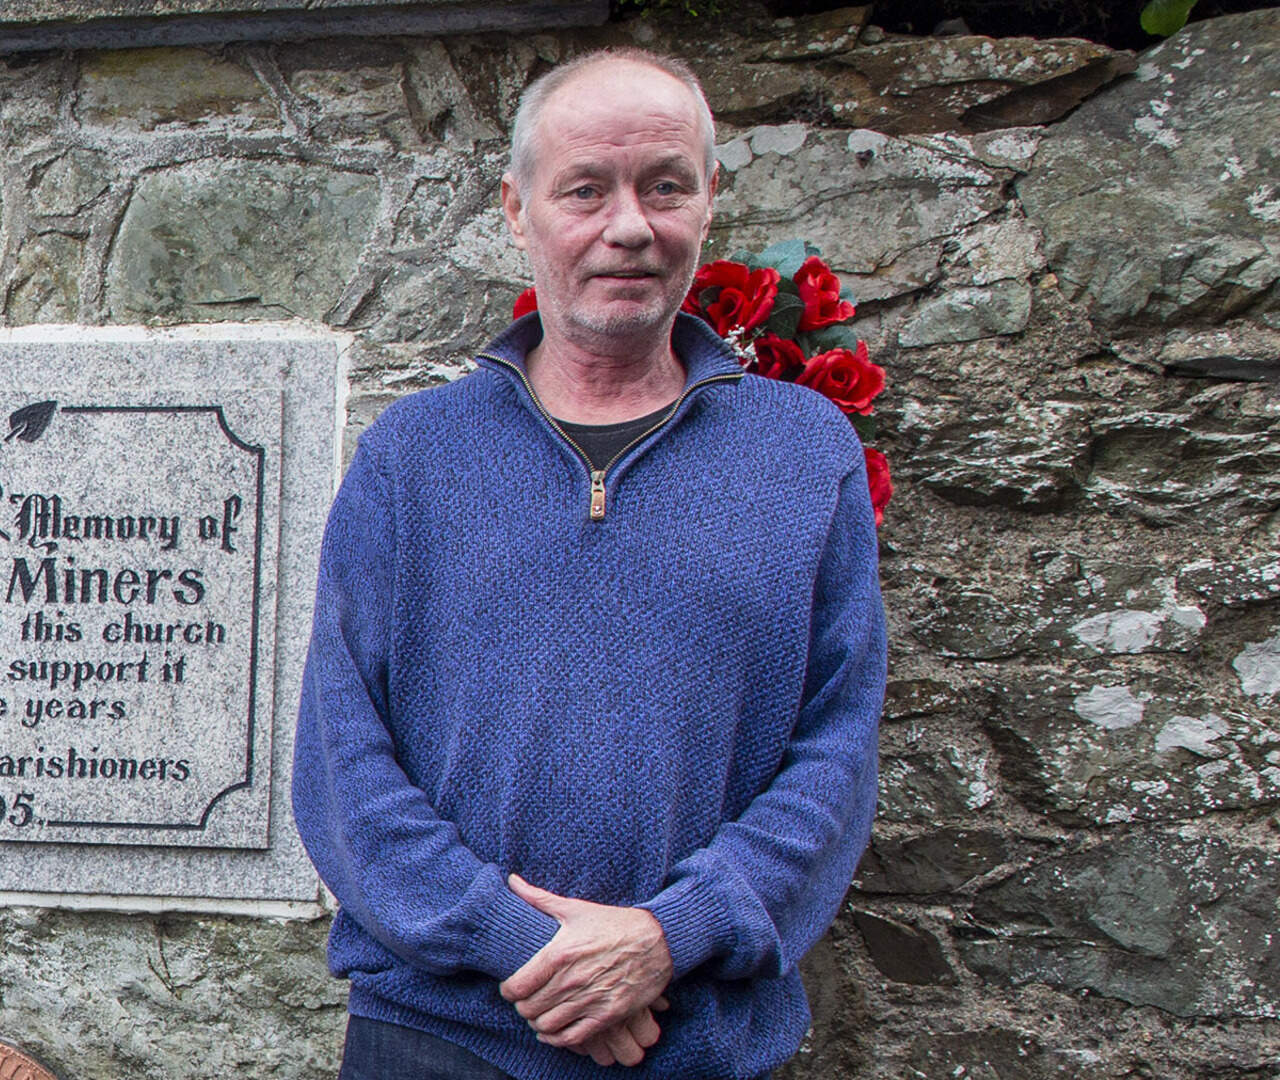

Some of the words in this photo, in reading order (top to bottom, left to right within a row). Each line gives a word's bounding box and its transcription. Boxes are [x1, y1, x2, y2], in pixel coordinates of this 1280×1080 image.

[9, 494, 182, 553] Memory
[198, 494, 243, 553] of
[6, 556, 206, 605] Miners
[21, 610, 83, 643] this
[102, 612, 226, 644] church
[6, 650, 149, 691] support
[162, 650, 188, 683] it
[21, 696, 127, 728] years
